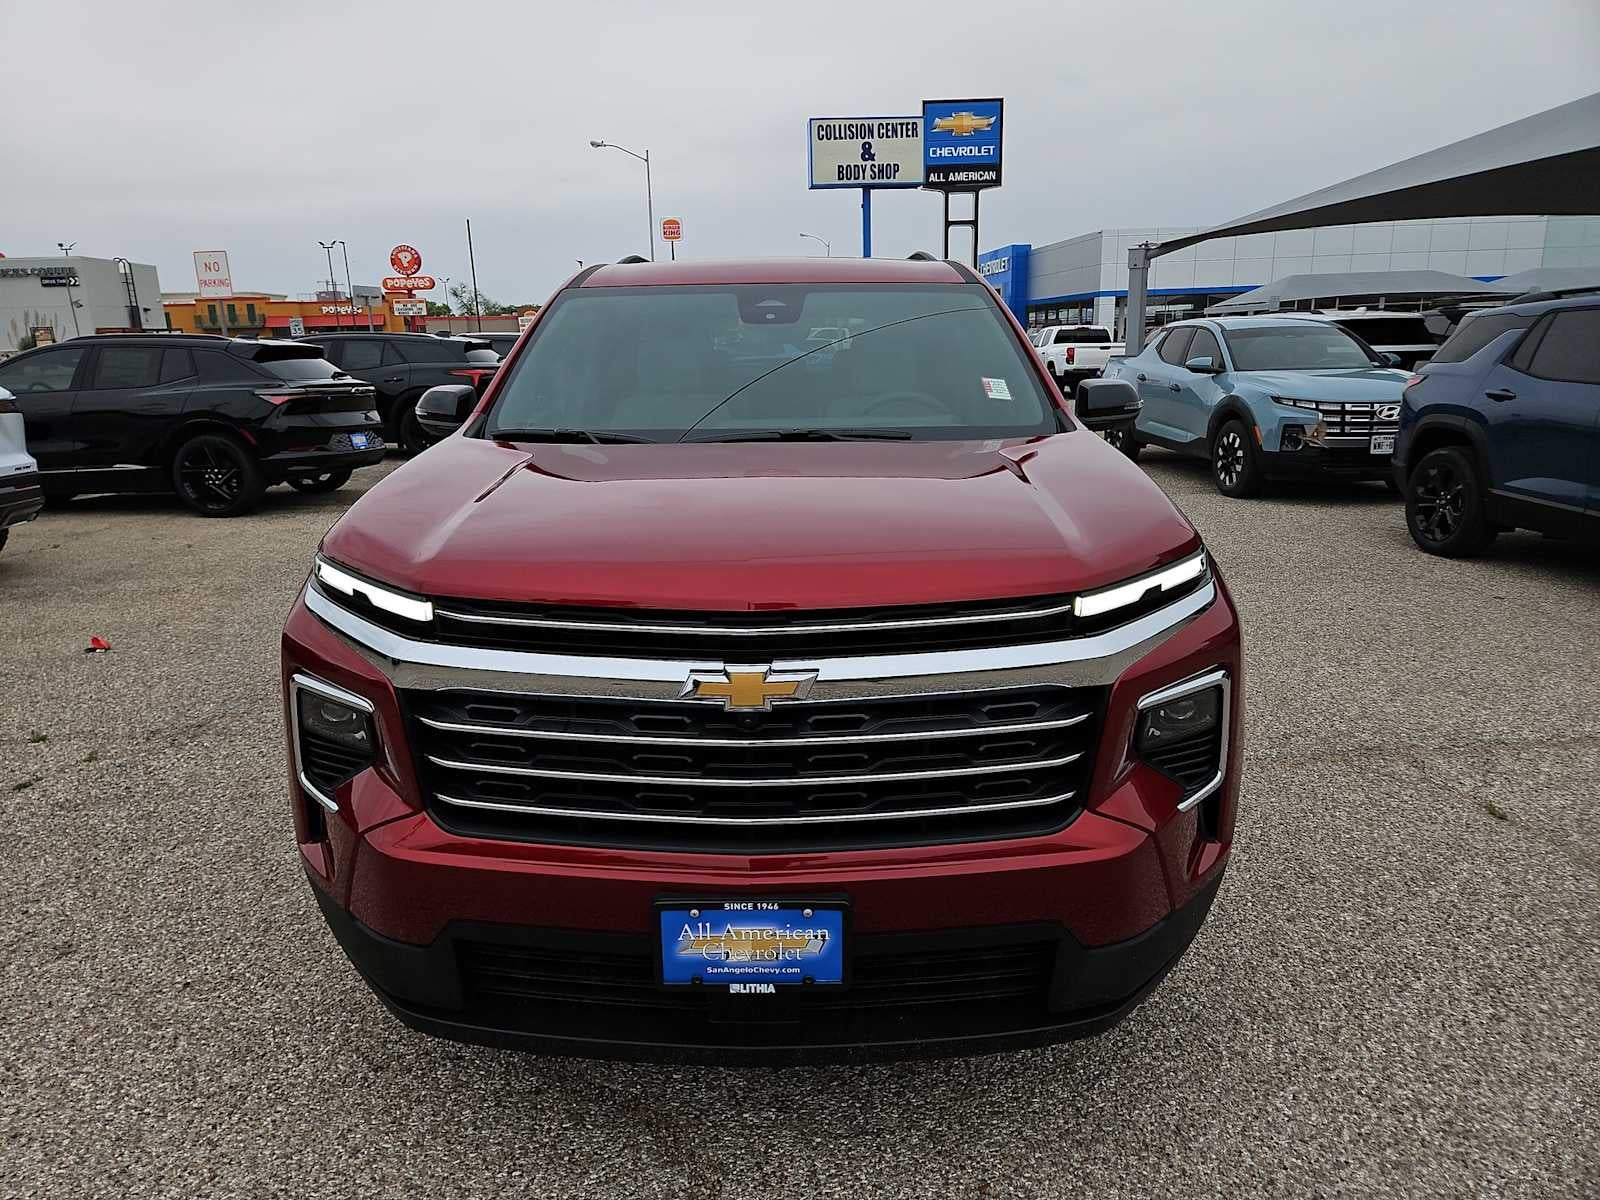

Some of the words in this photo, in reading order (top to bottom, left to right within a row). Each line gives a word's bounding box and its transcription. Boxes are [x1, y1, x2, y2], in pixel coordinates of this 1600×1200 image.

[817, 123, 874, 141] COLLISION
[877, 121, 919, 140] CENTER
[860, 141, 876, 162] &
[929, 145, 996, 158] CHEVROLET
[837, 164, 868, 181] BODY
[869, 163, 900, 180] SHOP
[928, 172, 946, 182] ALL
[948, 170, 996, 182] AMERICAN
[203, 261, 220, 272] NO
[200, 278, 231, 288] PARKING
[386, 277, 431, 289] POPEYES
[292, 327, 303, 335] 35
[724, 902, 753, 911] SINCE
[757, 902, 779, 911] 1946
[678, 923, 711, 941] All
[720, 923, 830, 941] American
[702, 942, 803, 961] Chevrolet
[706, 966, 801, 975] SanAngeloChevy.com
[740, 983, 776, 994] LITHIA
